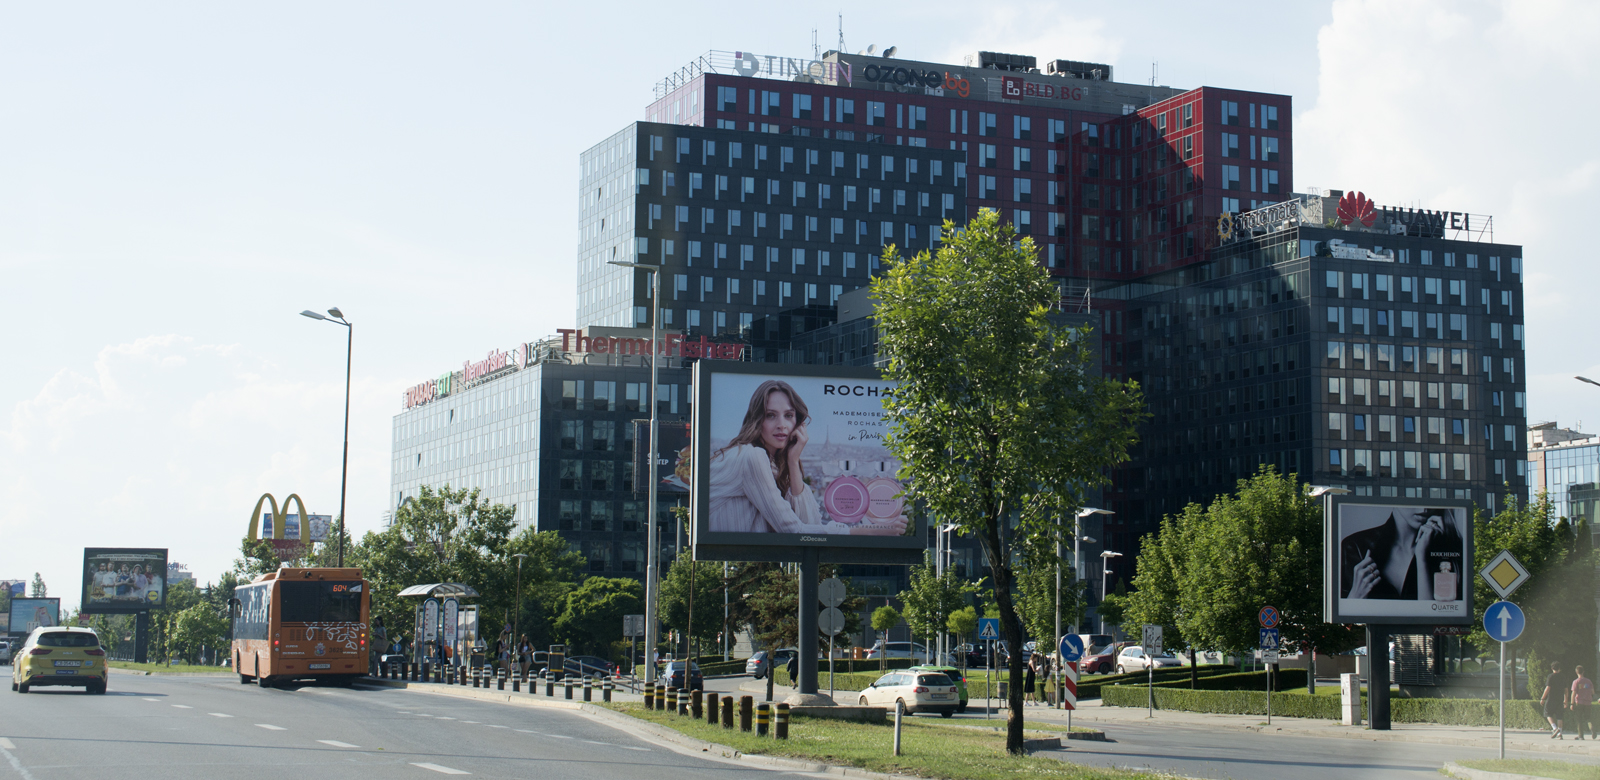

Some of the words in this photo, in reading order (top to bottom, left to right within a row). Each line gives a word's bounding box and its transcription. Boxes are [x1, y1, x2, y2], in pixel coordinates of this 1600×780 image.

[764, 54, 852, 84] TINQIN
[1025, 83, 1082, 101] BLD.BG
[1382, 205, 1470, 231] HUAWEI
[562, 352, 675, 369] SCIENT
[858, 429, 881, 442] Paris
[332, 584, 347, 592] 604
